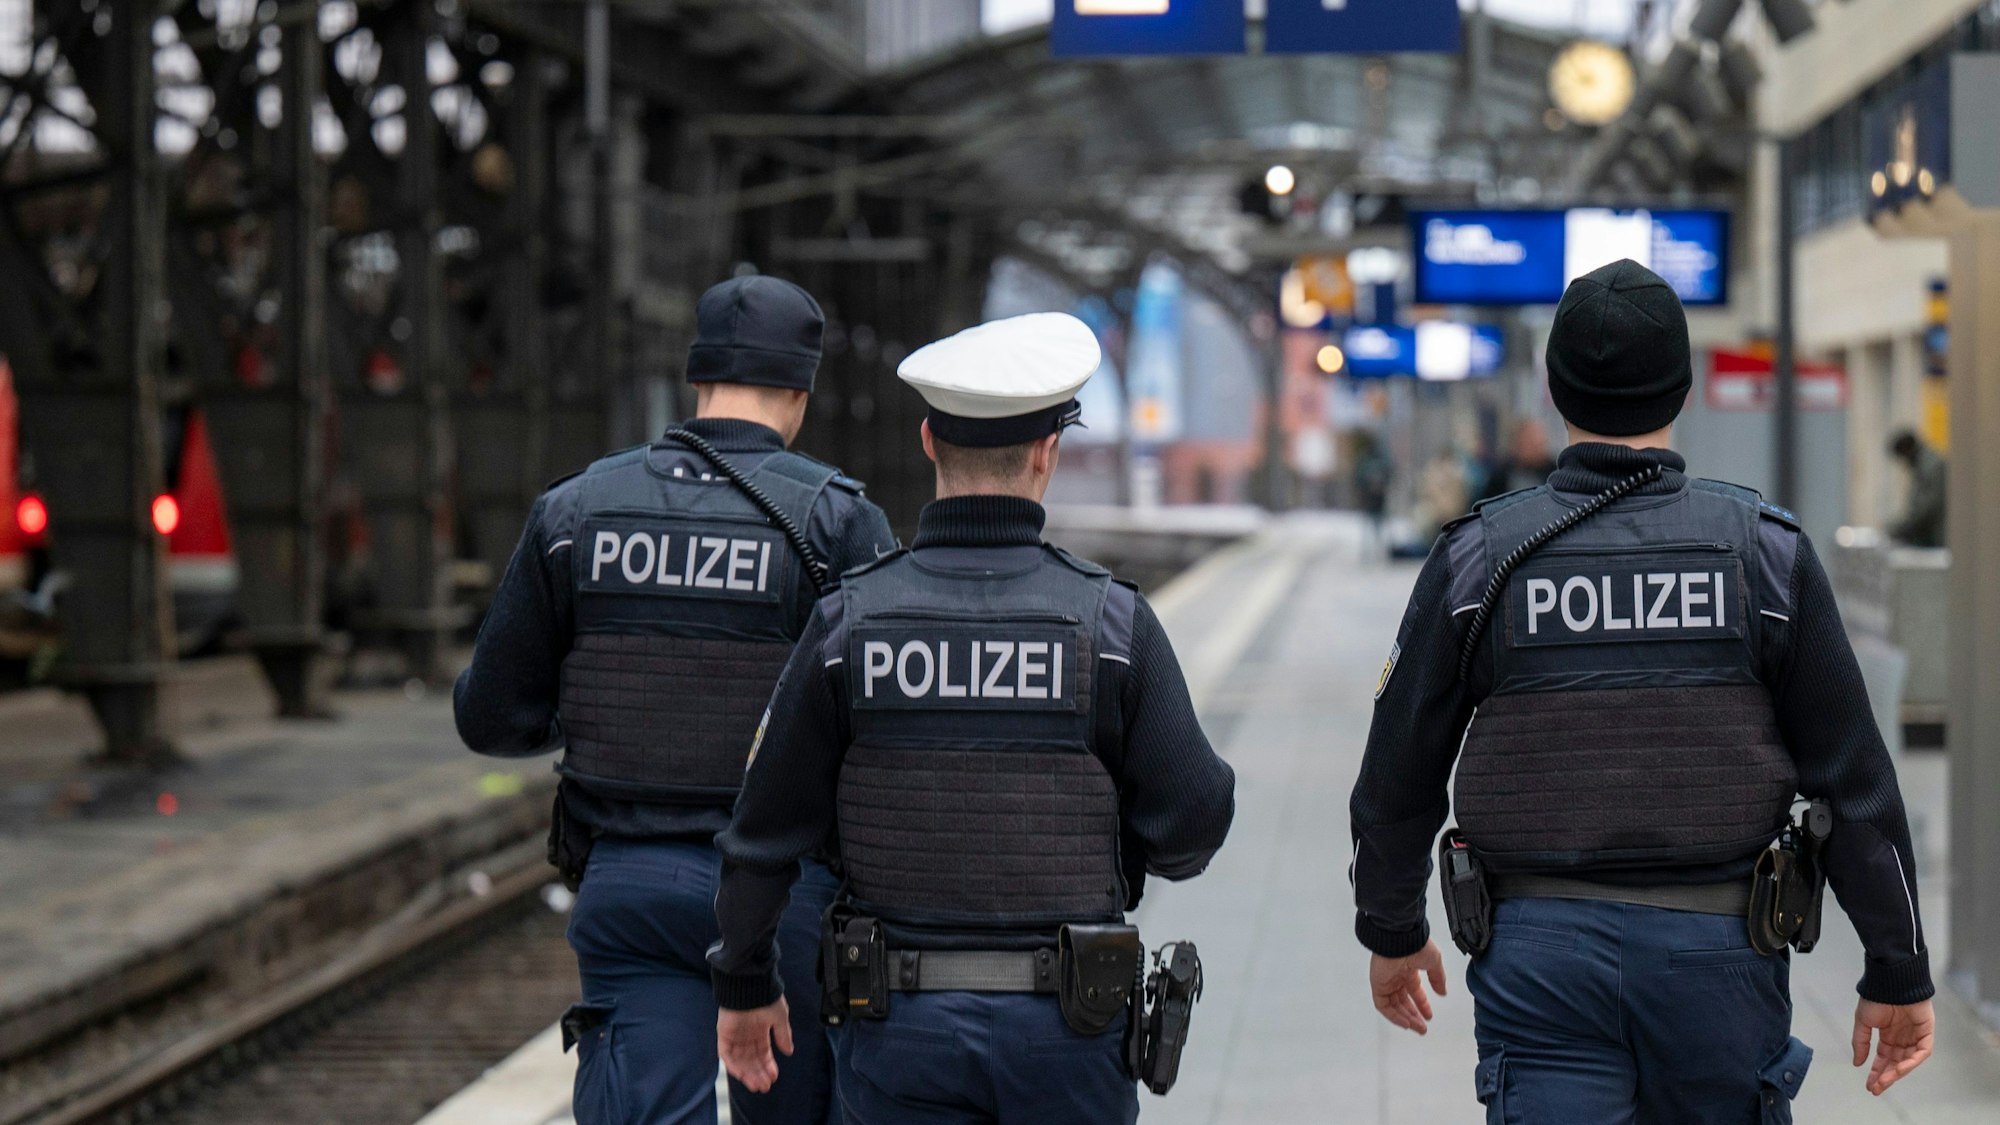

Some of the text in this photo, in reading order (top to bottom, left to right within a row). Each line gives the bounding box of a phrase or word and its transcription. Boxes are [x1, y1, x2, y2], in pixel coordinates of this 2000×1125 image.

[591, 530, 771, 592] POLIZEI
[1526, 571, 1726, 635] POLIZEI
[864, 639, 1063, 699] POLIZEI
